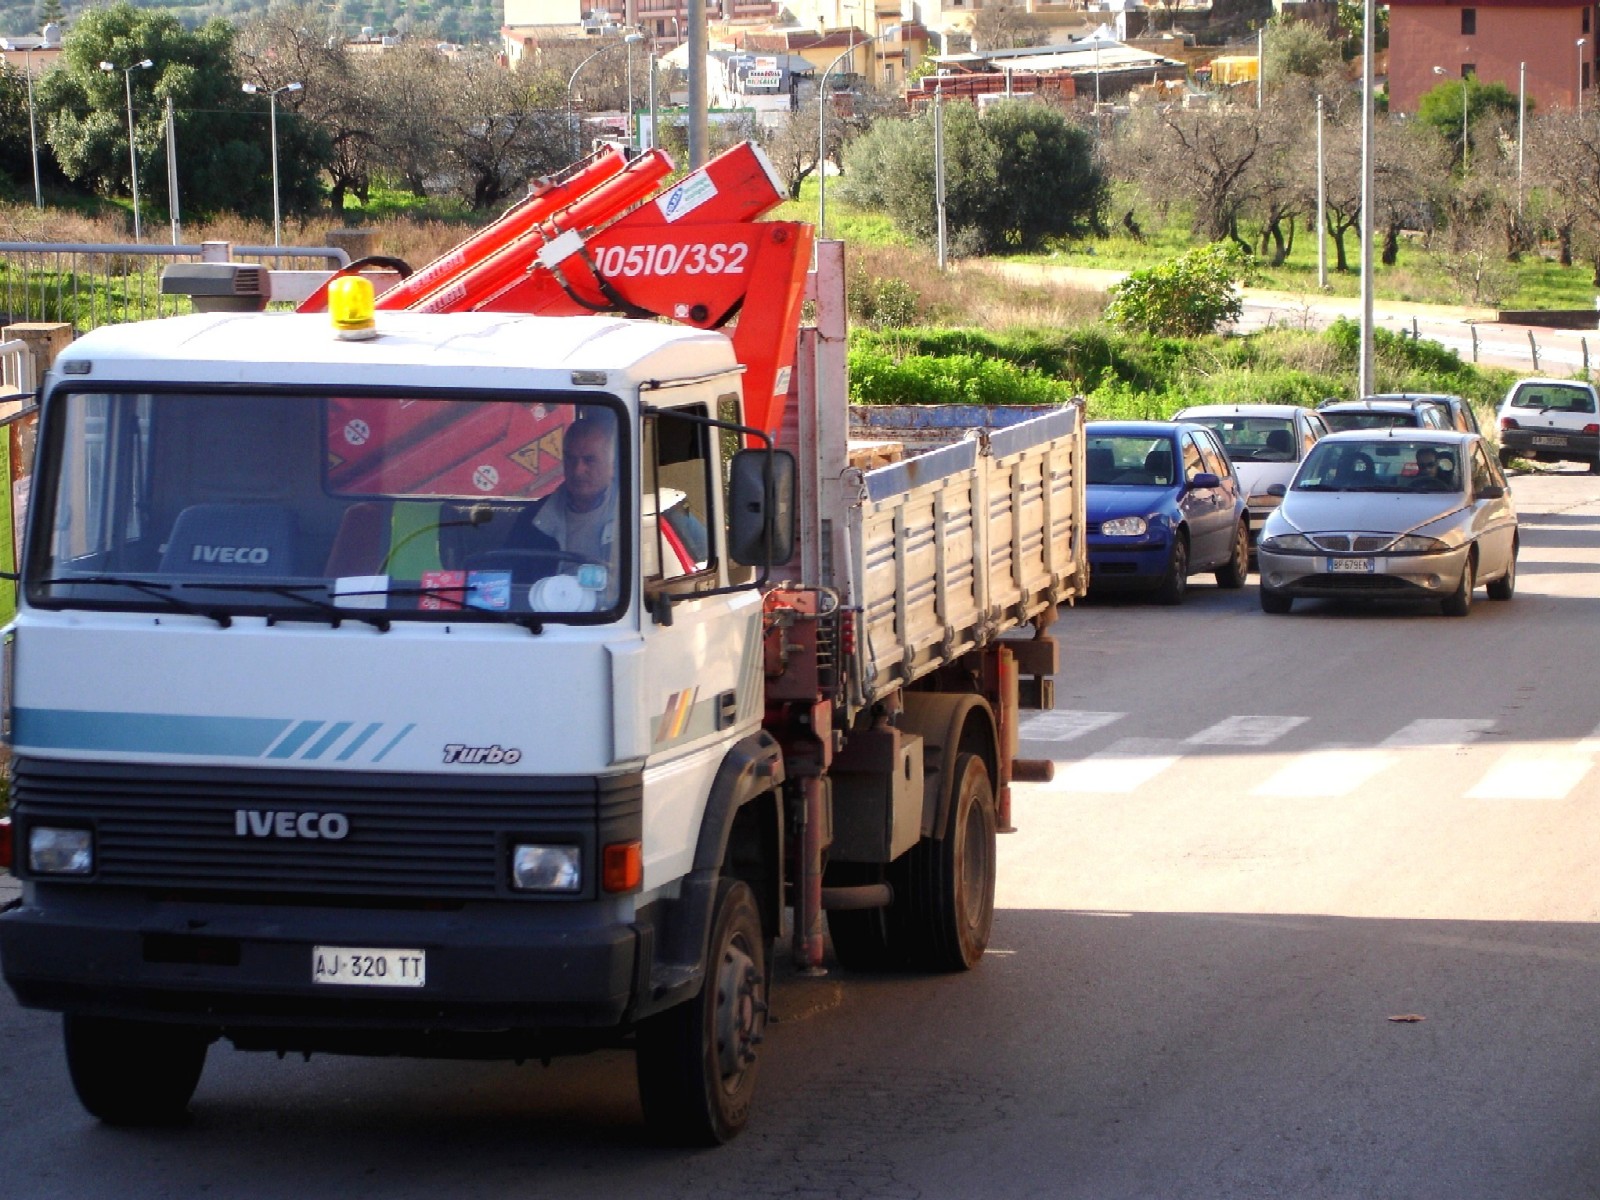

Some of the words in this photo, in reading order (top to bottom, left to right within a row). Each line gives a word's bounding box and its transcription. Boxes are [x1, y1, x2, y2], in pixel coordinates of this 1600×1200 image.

[594, 242, 748, 276] 10510/3S2
[193, 545, 269, 564] IVECO
[443, 744, 521, 764] Turbo
[235, 809, 349, 839] IVECO
